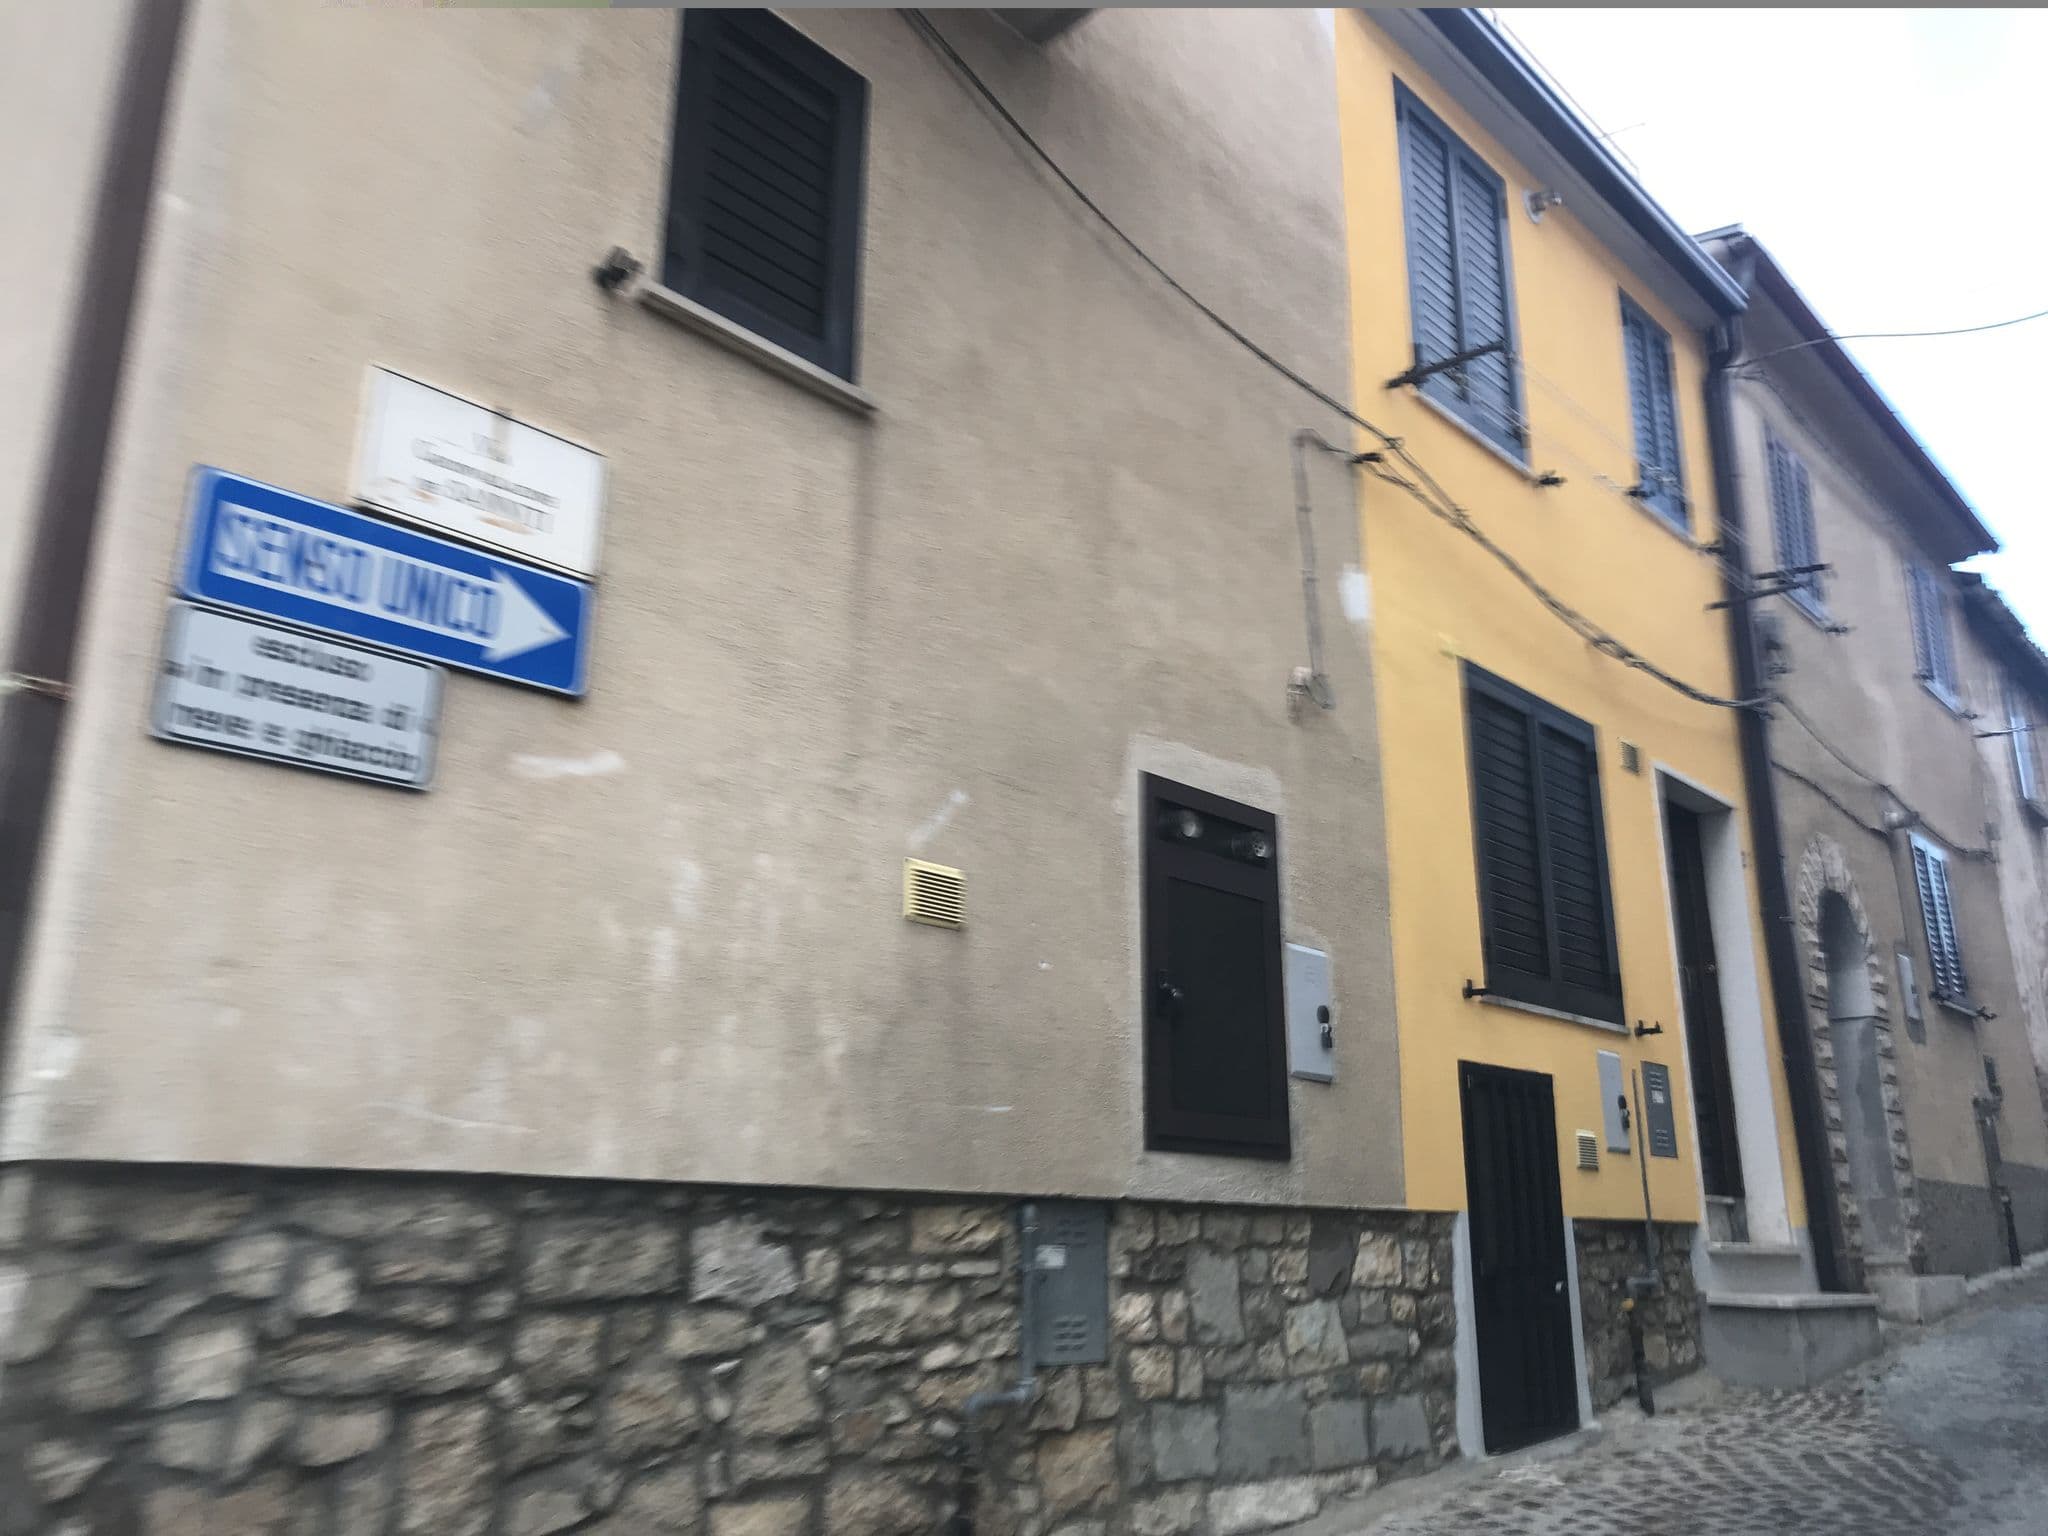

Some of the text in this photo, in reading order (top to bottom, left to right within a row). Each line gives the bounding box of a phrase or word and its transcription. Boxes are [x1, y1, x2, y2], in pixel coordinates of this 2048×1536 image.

[213, 510, 499, 642] SENSO UNICO
[252, 634, 374, 683] escluso
[236, 671, 374, 725] presenza
